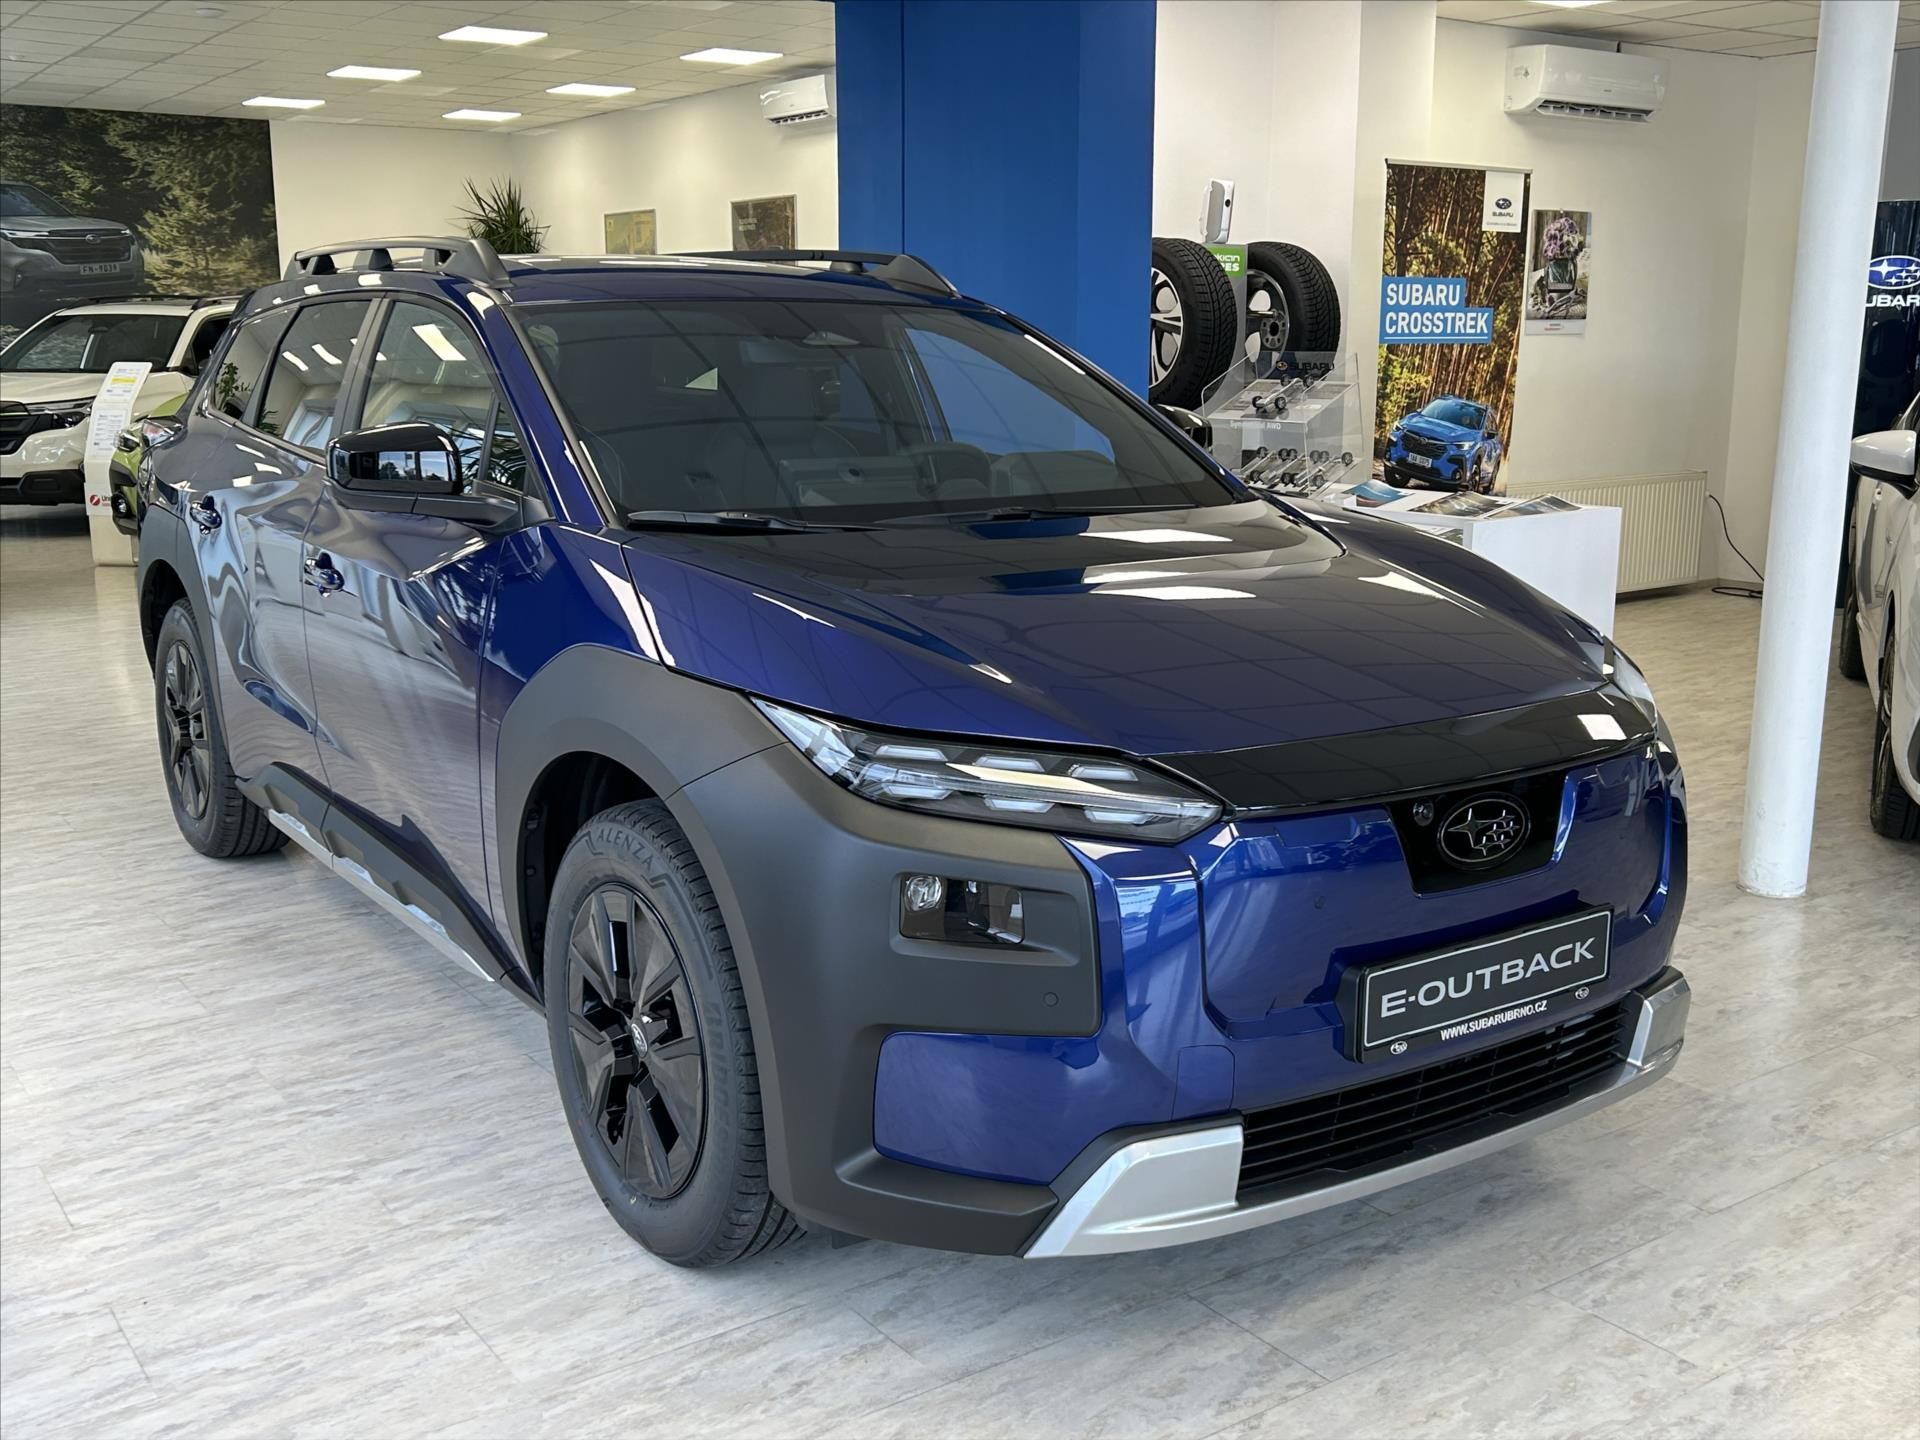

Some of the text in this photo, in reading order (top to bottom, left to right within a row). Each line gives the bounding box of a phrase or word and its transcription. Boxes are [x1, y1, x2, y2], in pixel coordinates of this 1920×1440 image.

[1214, 253, 1240, 262] kian
[1386, 283, 1460, 306] SUBARU
[1866, 294, 1920, 307] UBAR
[1385, 311, 1489, 334] CROSSTREK
[597, 827, 655, 872] ALENZA
[1380, 937, 1596, 1018] E-OUTBACK
[1440, 1000, 1548, 1041] WWW.SUBARUBRNO.CZ
